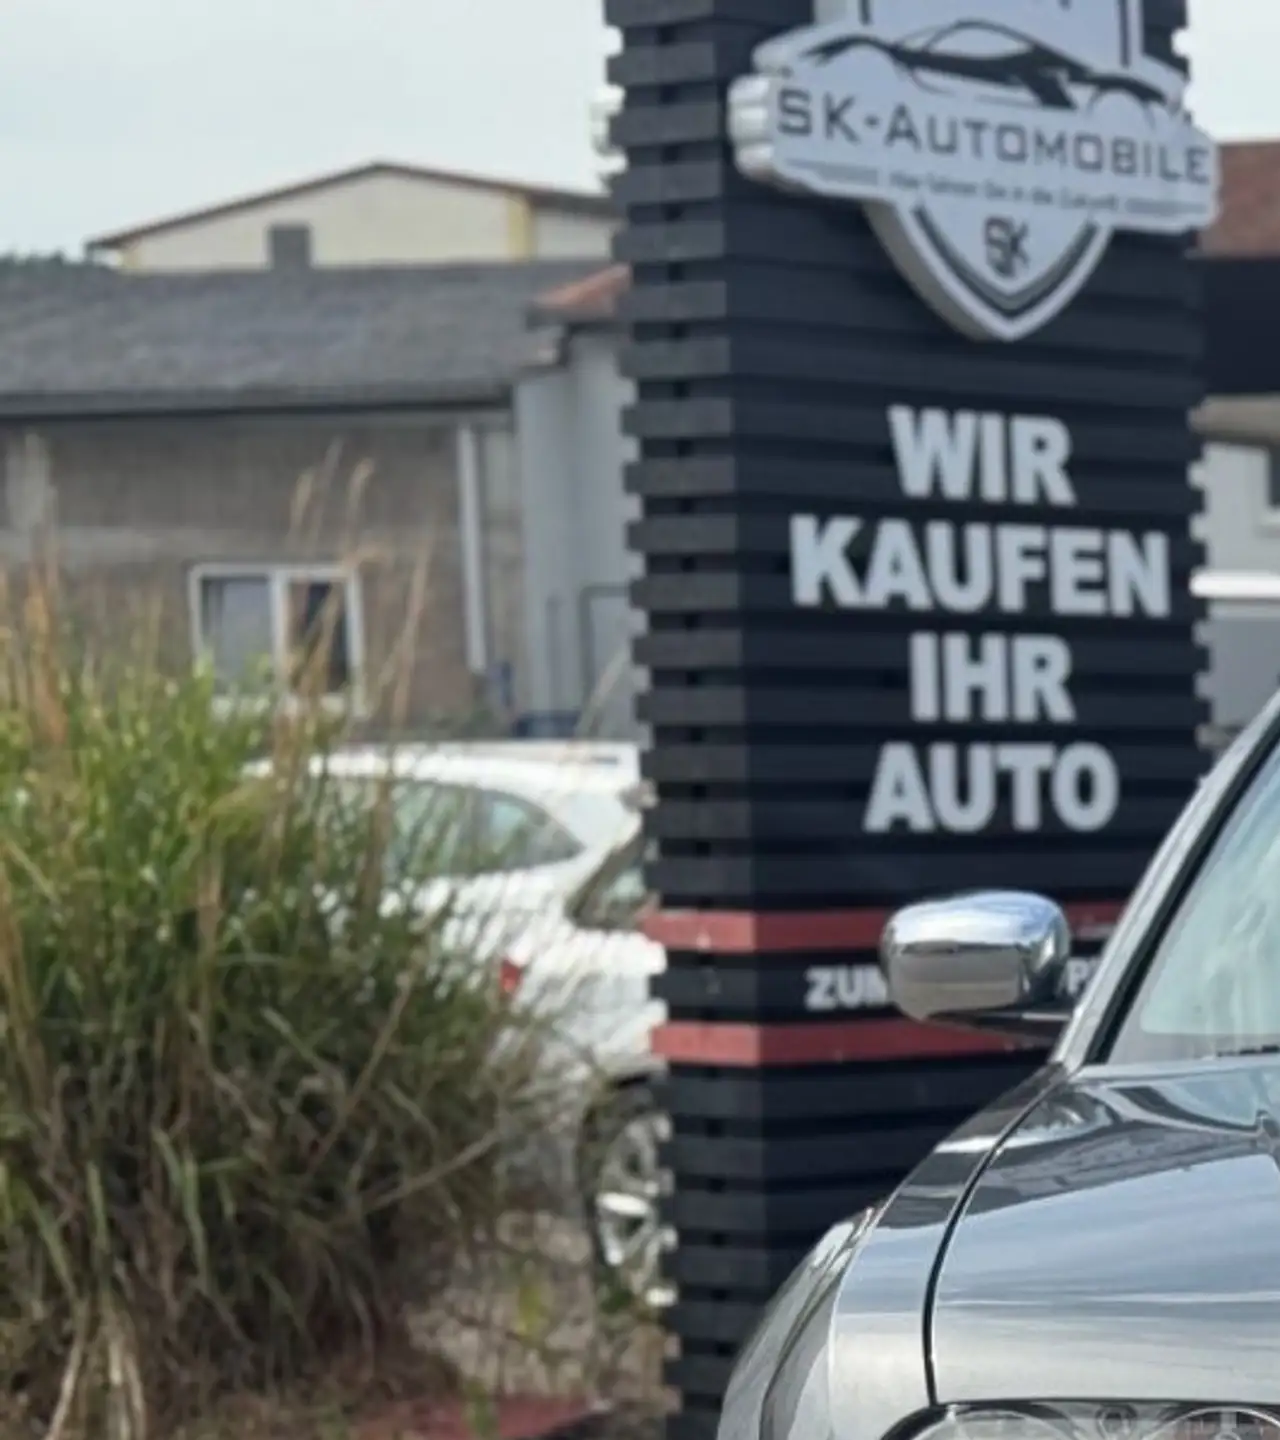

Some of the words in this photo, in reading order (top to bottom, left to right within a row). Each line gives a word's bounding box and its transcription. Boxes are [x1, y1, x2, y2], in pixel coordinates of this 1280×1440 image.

[778, 90, 1210, 184] SK-AUTOMOBILE
[888, 405, 1076, 505] WIR
[790, 514, 1170, 617] KAUFEN
[909, 633, 1075, 722] IHR
[863, 741, 1118, 832] AUTO
